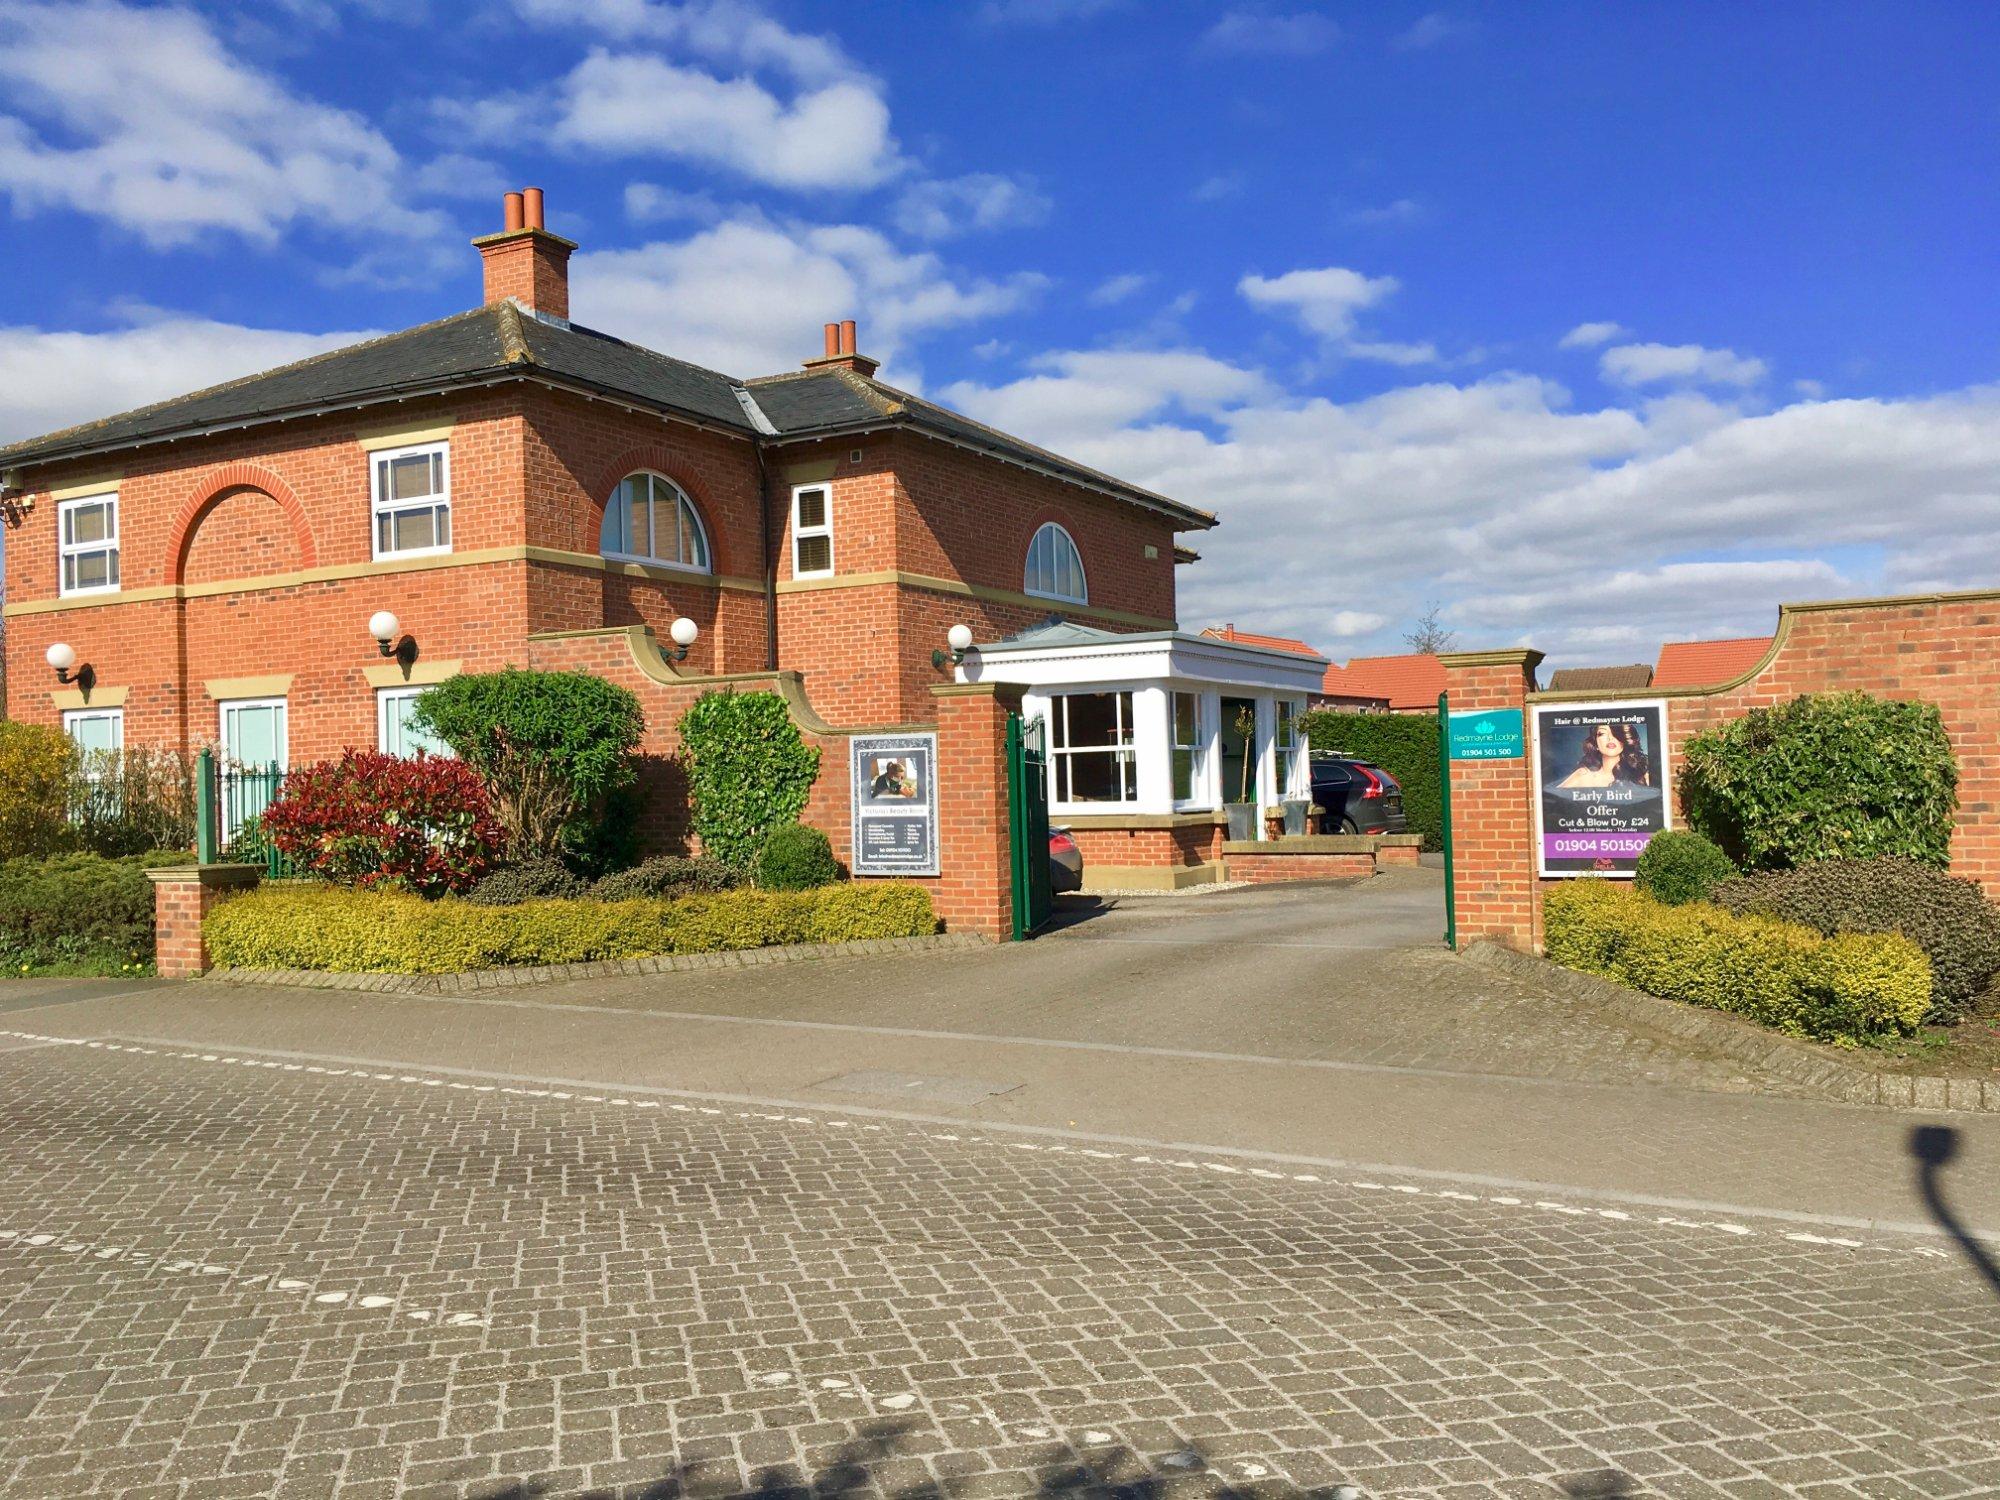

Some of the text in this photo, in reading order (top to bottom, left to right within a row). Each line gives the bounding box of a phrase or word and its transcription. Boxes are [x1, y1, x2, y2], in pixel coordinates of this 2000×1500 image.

[1572, 717, 1581, 725] @
[1582, 716, 1620, 725] Redmayne
[1622, 714, 1645, 723] Lodge
[1453, 733, 1519, 742] Redmayne Lodge
[1572, 789, 1633, 804] Early Bird
[1586, 805, 1619, 816] Offer
[1558, 817, 1649, 828] Cut & Blow Dry £24
[1555, 839, 1597, 851] 01904
